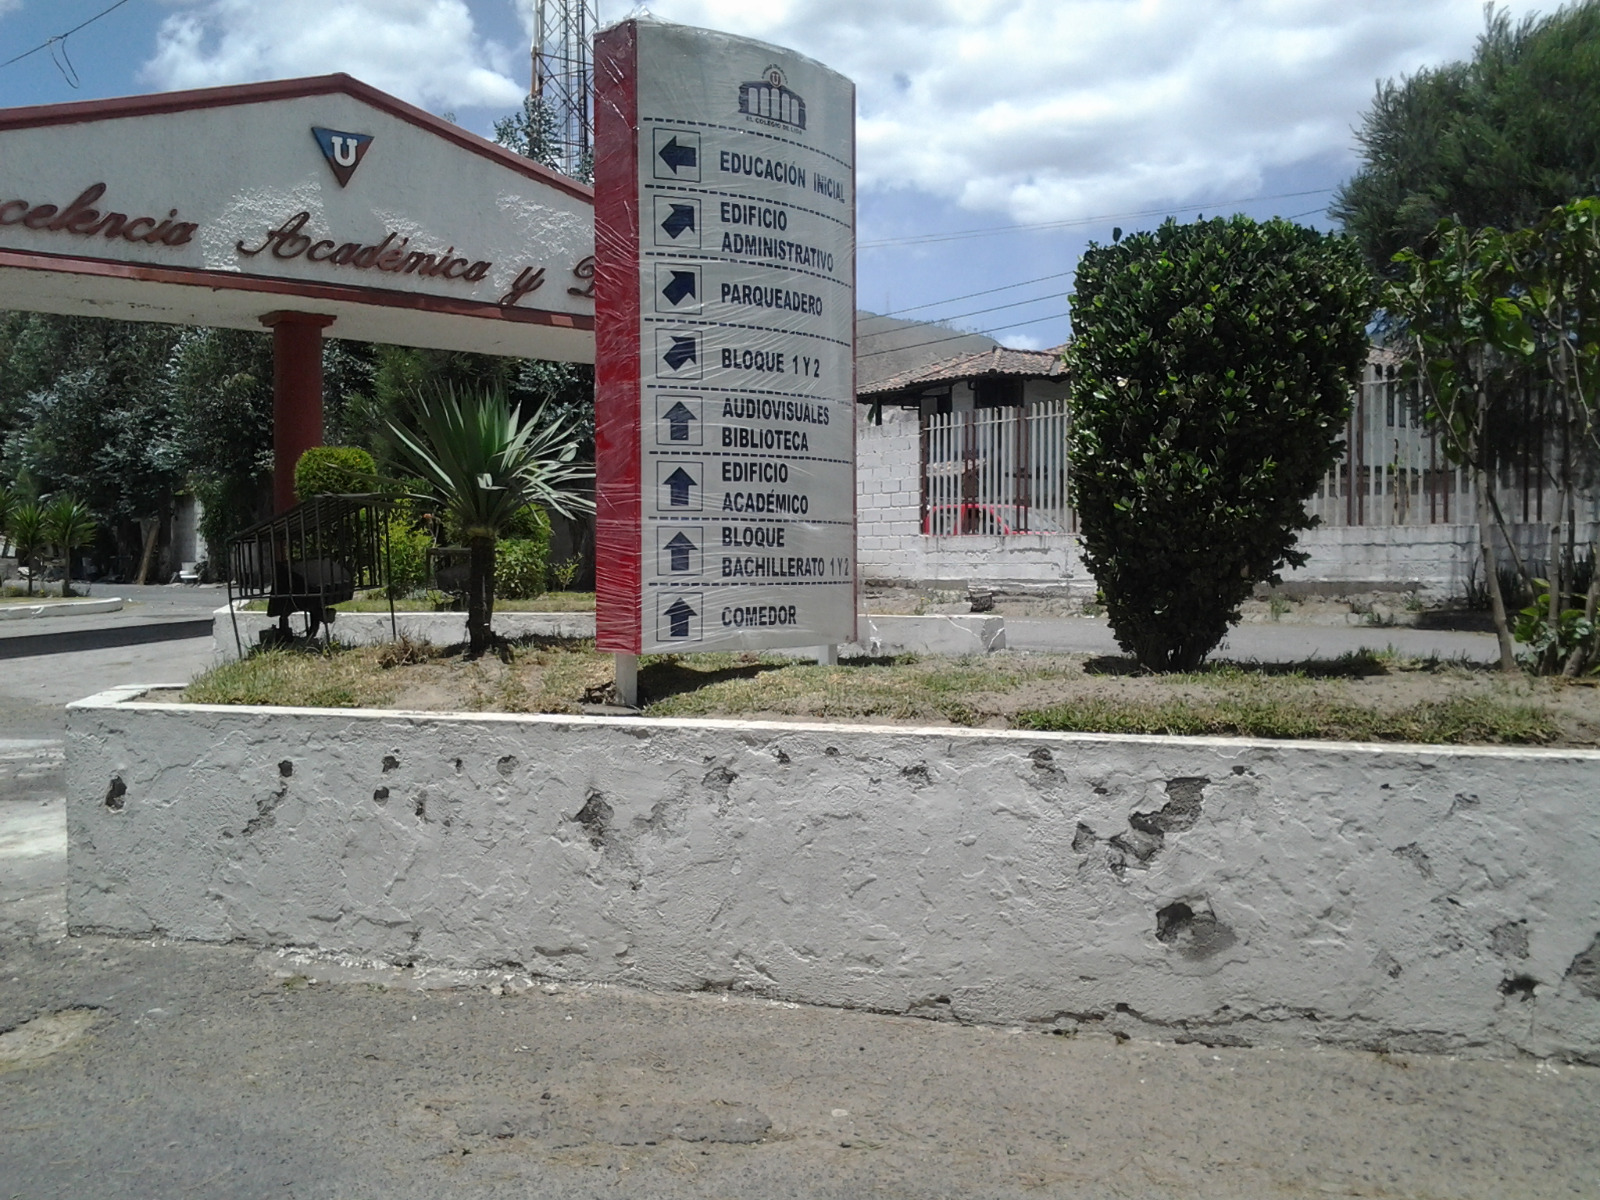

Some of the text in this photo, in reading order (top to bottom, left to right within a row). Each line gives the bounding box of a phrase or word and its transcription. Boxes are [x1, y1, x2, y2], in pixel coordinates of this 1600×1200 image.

[330, 135, 359, 167] U
[720, 150, 846, 204] EDUCACIÓN INICIAL
[720, 201, 788, 231] EDIFICIO
[236, 211, 492, 282] Académica
[498, 266, 546, 307] y
[721, 232, 834, 273] ADMINISTRATIVO
[721, 283, 823, 317] PARQUEADERO
[721, 348, 820, 378] BLOQUE 1 Y 2
[722, 397, 829, 426] AUDIOVISUALES
[722, 427, 809, 452] BIBLIOTECA
[722, 461, 788, 483] EDIFICIO
[722, 489, 809, 515] ACADÉMICO
[722, 526, 785, 549] BLOQUE
[721, 556, 849, 577] BACHILLERATO 1 Y 2
[721, 605, 797, 628] COMEDOR
